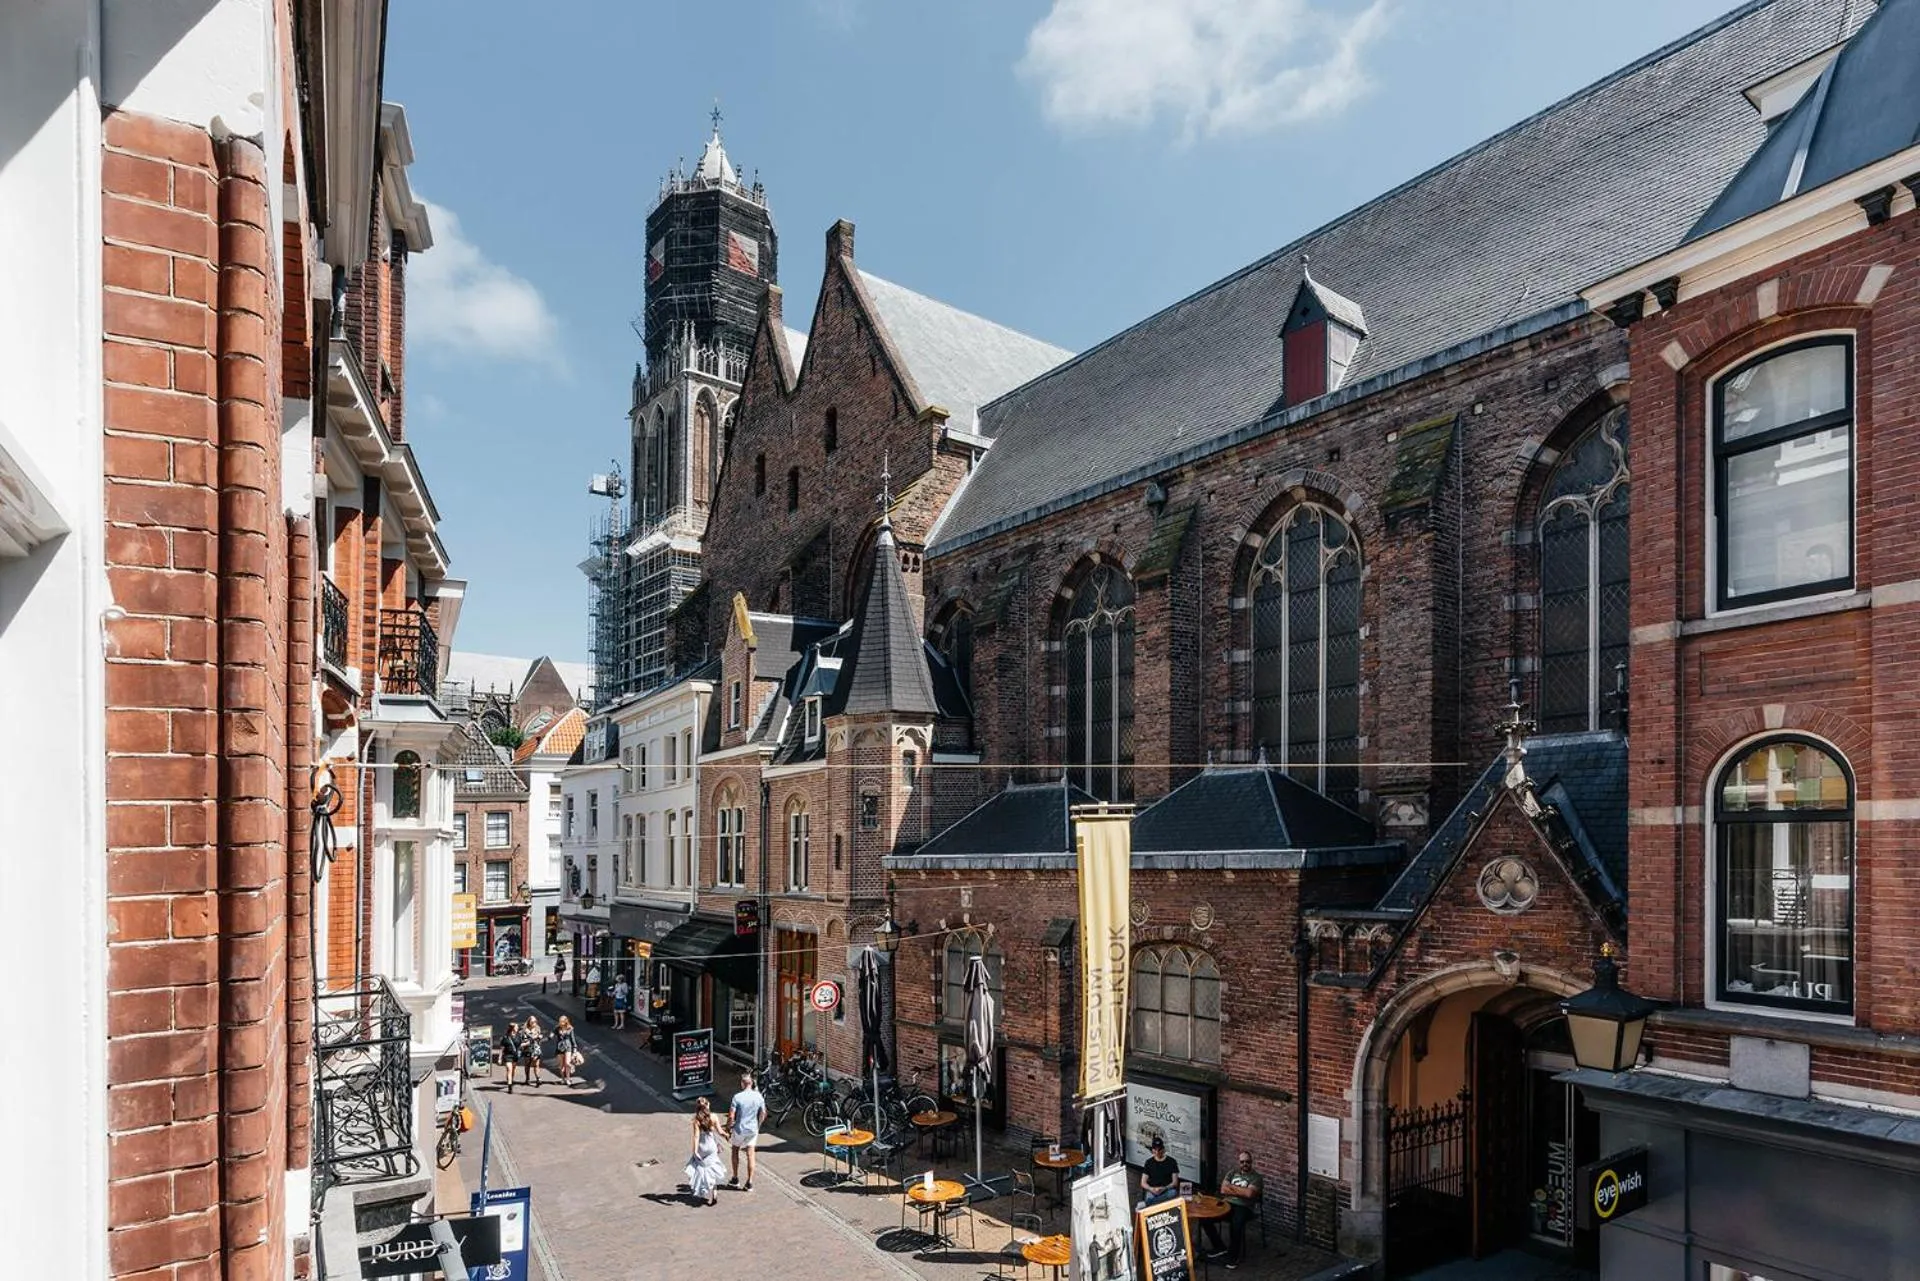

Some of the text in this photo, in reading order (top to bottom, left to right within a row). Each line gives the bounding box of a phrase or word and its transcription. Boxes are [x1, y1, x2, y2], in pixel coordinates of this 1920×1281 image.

[1089, 968, 1103, 1085] MUSEUM
[1133, 1096, 1169, 1112] MUSEUM
[1547, 1141, 1566, 1233] MUSEUM
